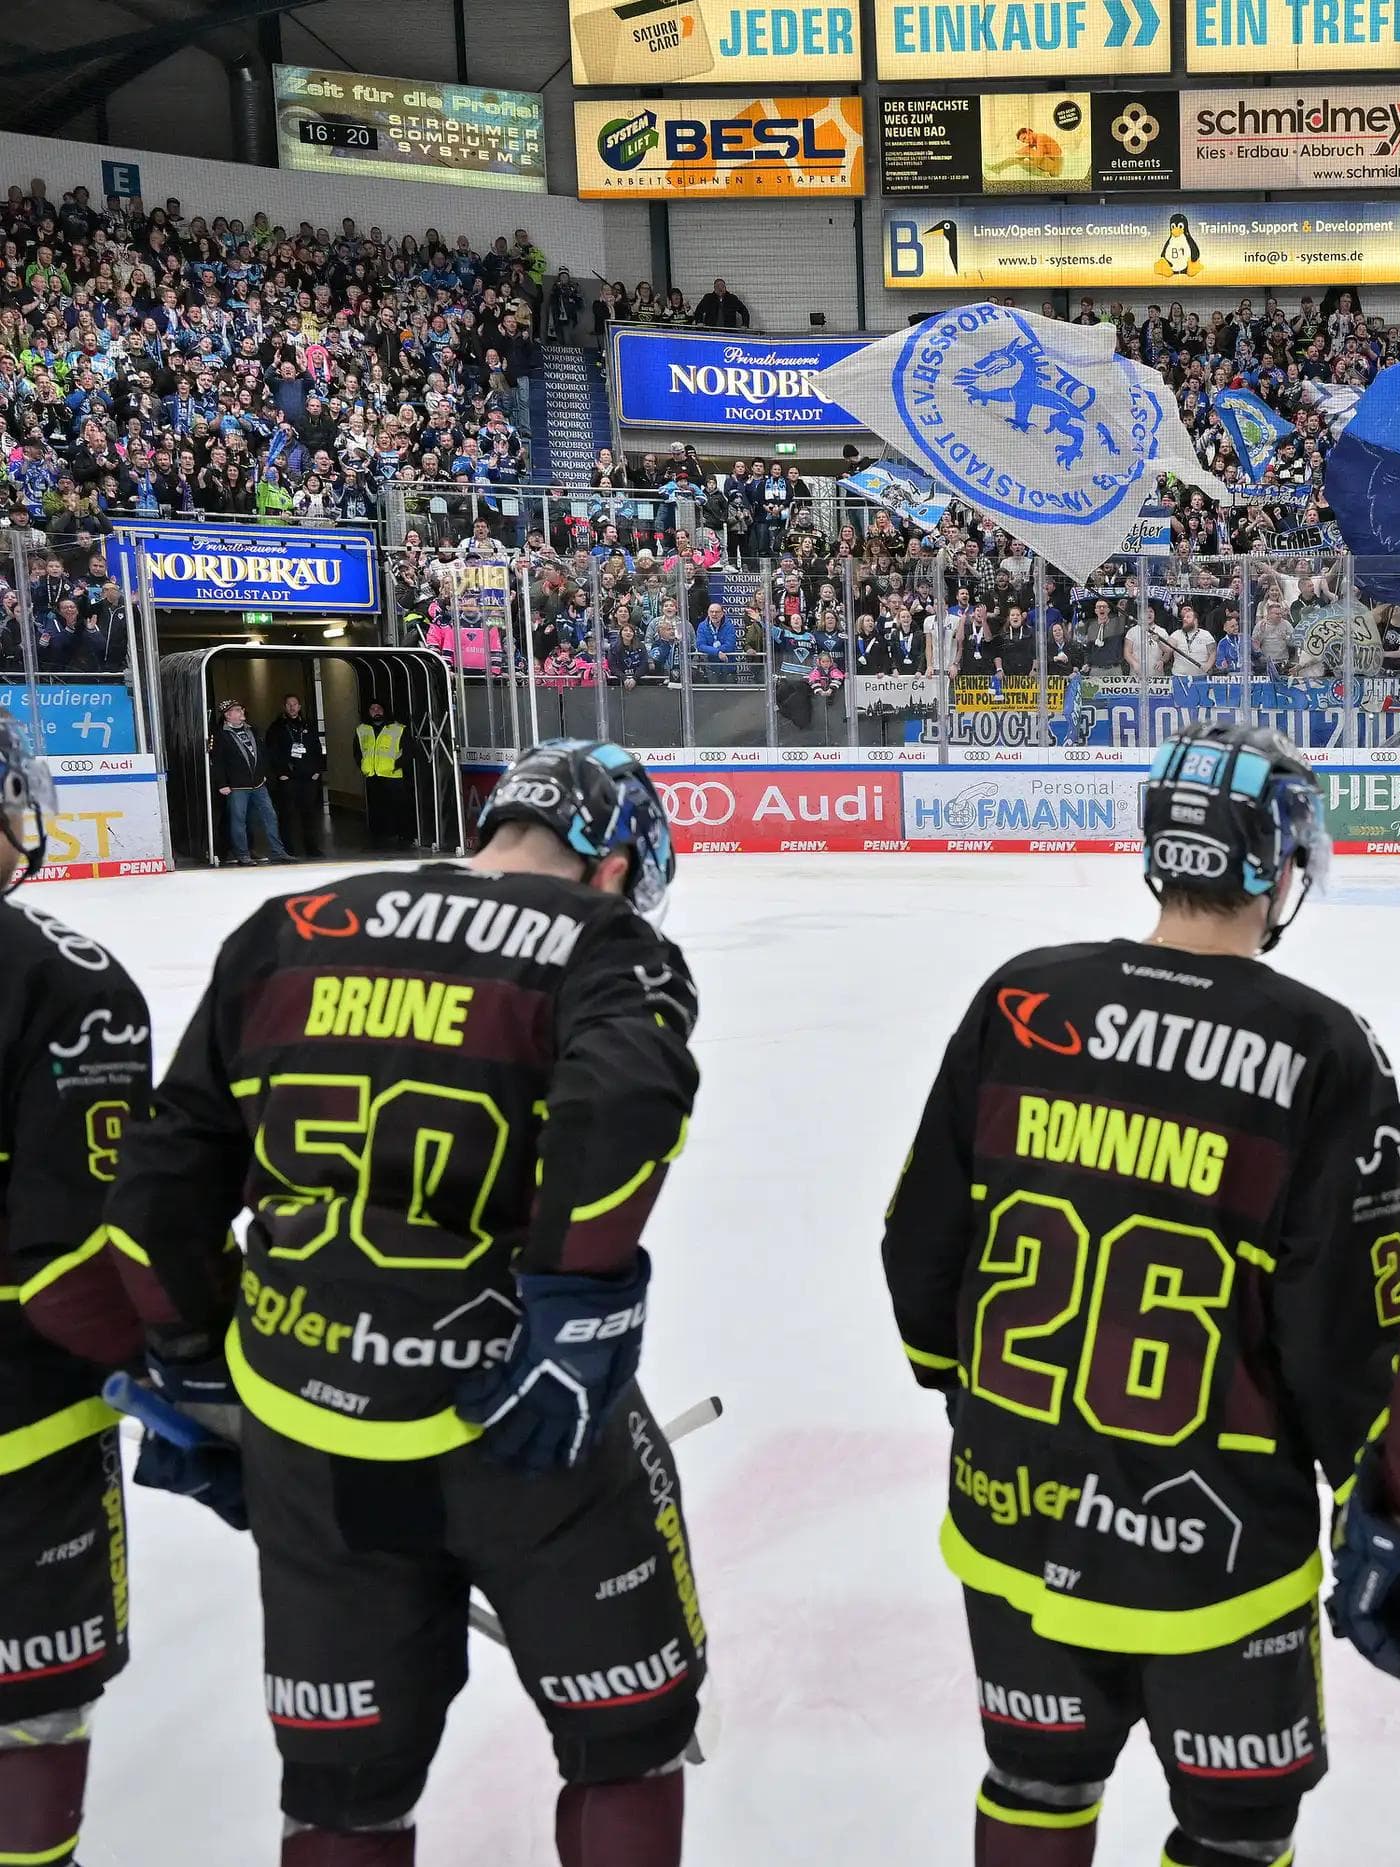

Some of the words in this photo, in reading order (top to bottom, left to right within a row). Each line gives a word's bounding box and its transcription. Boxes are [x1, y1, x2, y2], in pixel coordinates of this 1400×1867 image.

[633, 19, 678, 43] SATURN
[720, 8, 854, 57] JEDER
[894, 2, 1086, 53] EINKAUF
[1196, 0, 1267, 46] EIN
[649, 33, 680, 53] CARD
[288, 77, 344, 98] Zeit
[352, 85, 394, 104] für
[403, 91, 443, 109] die
[884, 100, 906, 113] DER
[907, 99, 970, 112] EINFACHSTE
[606, 111, 649, 150] SYSTEM
[884, 114, 909, 126] WEG
[910, 113, 934, 125] ZUM
[885, 126, 922, 138] NEUEN
[923, 125, 946, 137] BAD
[389, 127, 539, 153] COMPUTER
[627, 132, 652, 157] LIFT
[664, 118, 846, 161] BESL
[1196, 146, 1226, 159] Kies
[1237, 145, 1289, 158] Erdbau
[1300, 144, 1364, 158] Abbruch
[398, 141, 533, 166] SYSTEME
[1110, 157, 1161, 169] elements
[113, 166, 130, 193] E
[605, 175, 744, 186] ARBEITSBÜHNEN
[756, 175, 763, 185] &
[776, 174, 848, 184] STAPLER
[973, 224, 1042, 239] Linux/Open
[1043, 224, 1083, 237] Source
[1085, 223, 1151, 239] Consulting,
[1199, 222, 1250, 236] Training,
[1251, 220, 1299, 235] Support
[1302, 220, 1313, 233] &
[1315, 219, 1394, 236] Development
[723, 345, 821, 367] Privatbrauerei
[725, 407, 823, 422] INGOLSTADT
[145, 550, 342, 591] NORDBRÄU
[196, 587, 292, 601] INGOLSTADT
[20, 690, 112, 706] studieren
[864, 680, 908, 692] Panther
[911, 680, 926, 692] 64
[647, 752, 676, 761] Audi
[813, 751, 841, 760] Audi
[994, 751, 1022, 760] Audi
[1183, 752, 1218, 777] 26
[1031, 780, 1115, 796] Personal
[751, 785, 884, 822] Audi
[915, 798, 1117, 831] HOFMANN
[366, 890, 586, 967] SATURN
[304, 975, 474, 1047] BRUNE
[1088, 1003, 1307, 1109] SATURN
[1016, 1094, 1229, 1196] RONNING
[254, 1073, 510, 1270] 50
[971, 1189, 1236, 1447] 26
[955, 1448, 1207, 1554] zieglerhaus
[540, 1637, 688, 1704] CINQUE
[265, 1675, 377, 1721] INQUE
[978, 1677, 1085, 1725] INQUE
[1173, 1716, 1314, 1770] CINQUE
